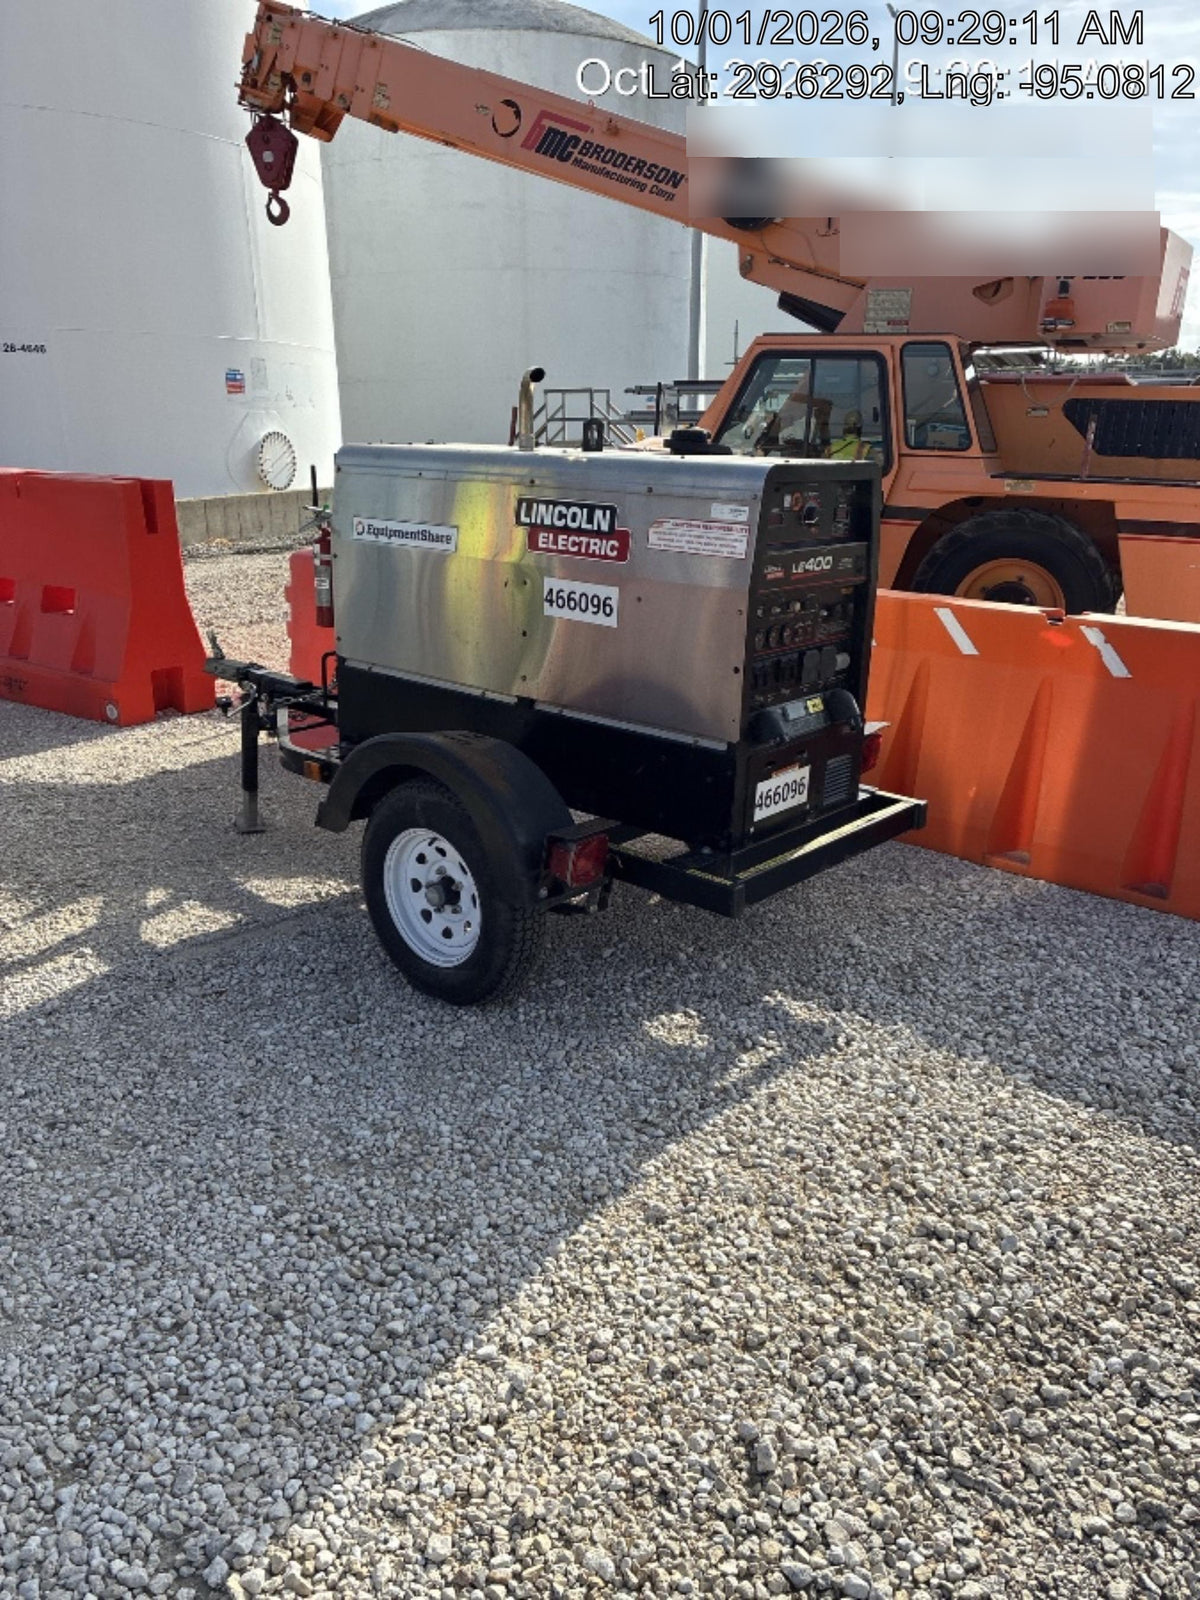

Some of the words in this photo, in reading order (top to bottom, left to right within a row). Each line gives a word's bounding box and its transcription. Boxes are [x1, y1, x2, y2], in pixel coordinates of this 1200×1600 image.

[570, 157, 647, 193] Manufacturing
[578, 140, 686, 189] BRODERSON
[520, 502, 611, 532] LINCOLN
[366, 524, 453, 545] EquipmentShare
[538, 532, 620, 558] ELECTRIC
[792, 556, 833, 574] LE400
[544, 588, 614, 618] 466096
[755, 776, 806, 811] 466096
